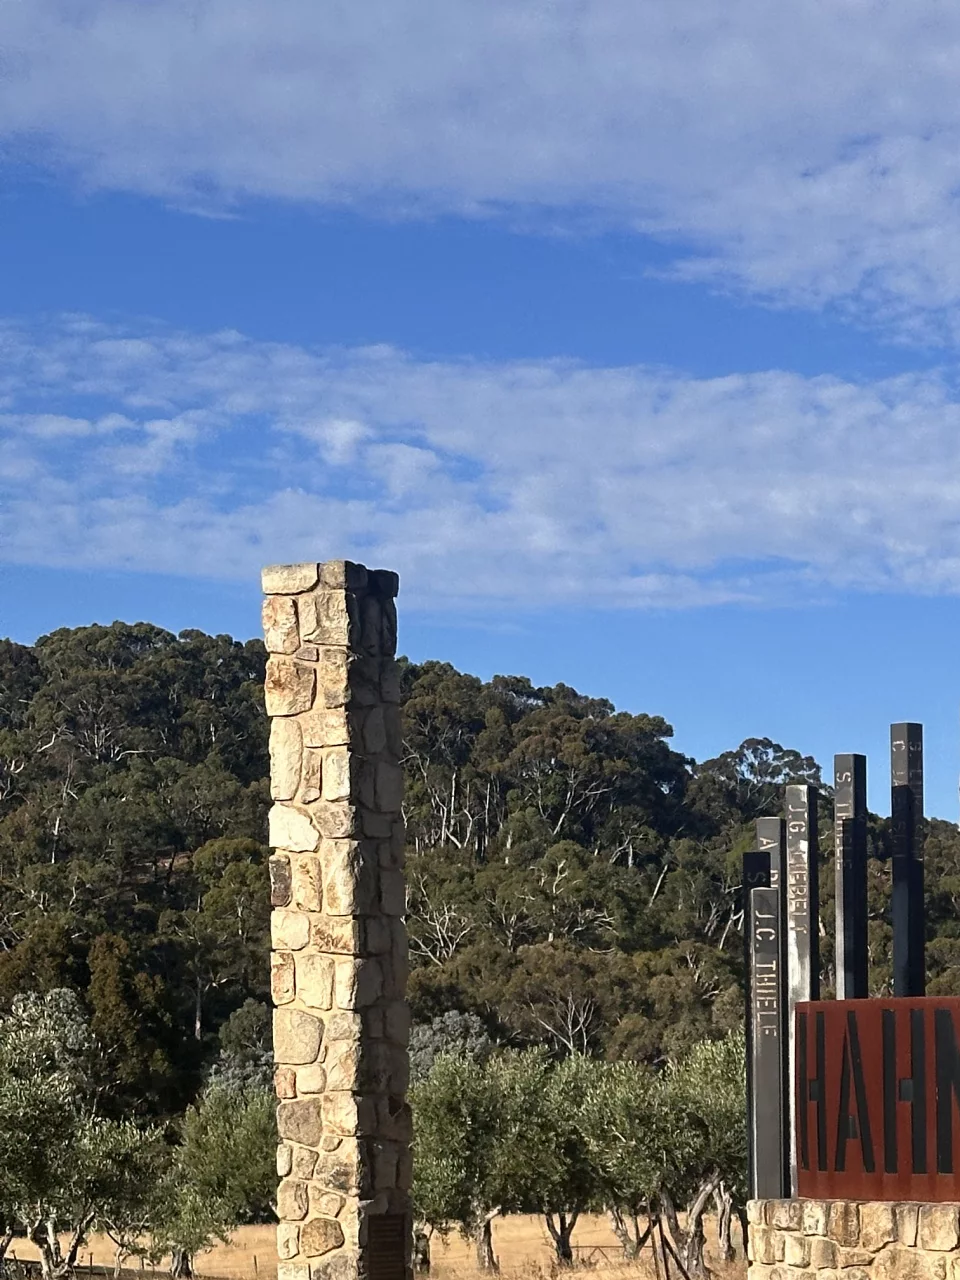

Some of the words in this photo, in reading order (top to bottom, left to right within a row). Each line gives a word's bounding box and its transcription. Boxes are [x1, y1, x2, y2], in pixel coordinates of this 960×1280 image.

[836, 771, 852, 790] S.
[788, 804, 807, 840] J.G.
[755, 909, 777, 948] J.C.
[755, 959, 777, 1039] THIELE
